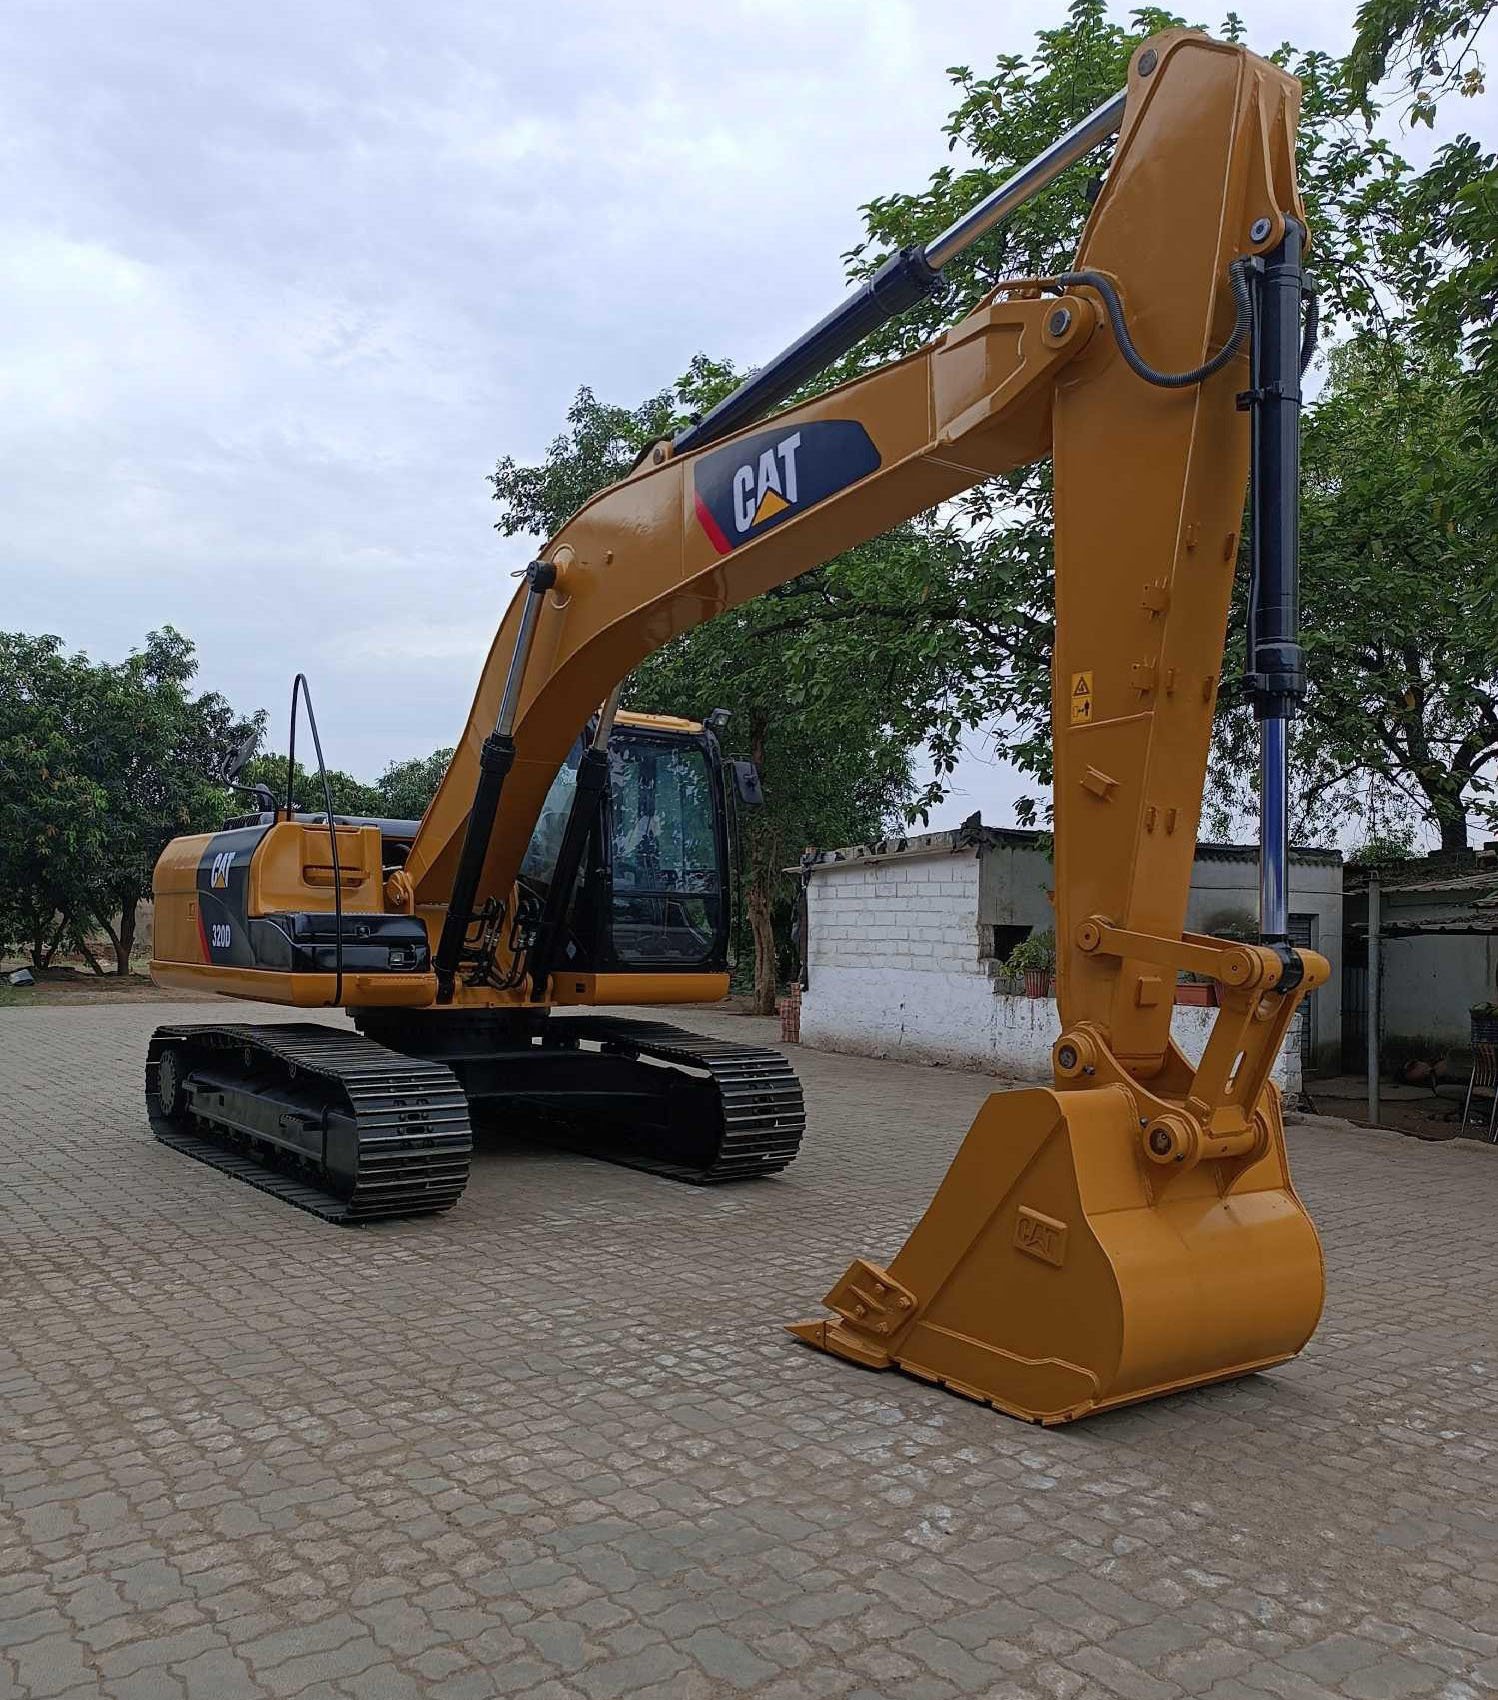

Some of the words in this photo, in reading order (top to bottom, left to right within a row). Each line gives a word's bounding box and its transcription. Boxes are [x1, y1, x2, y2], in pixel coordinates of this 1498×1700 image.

[732, 431, 801, 533] CAT
[210, 851, 236, 889] CAT
[211, 922, 232, 949] 320D
[1017, 1217, 1061, 1257] CAT
